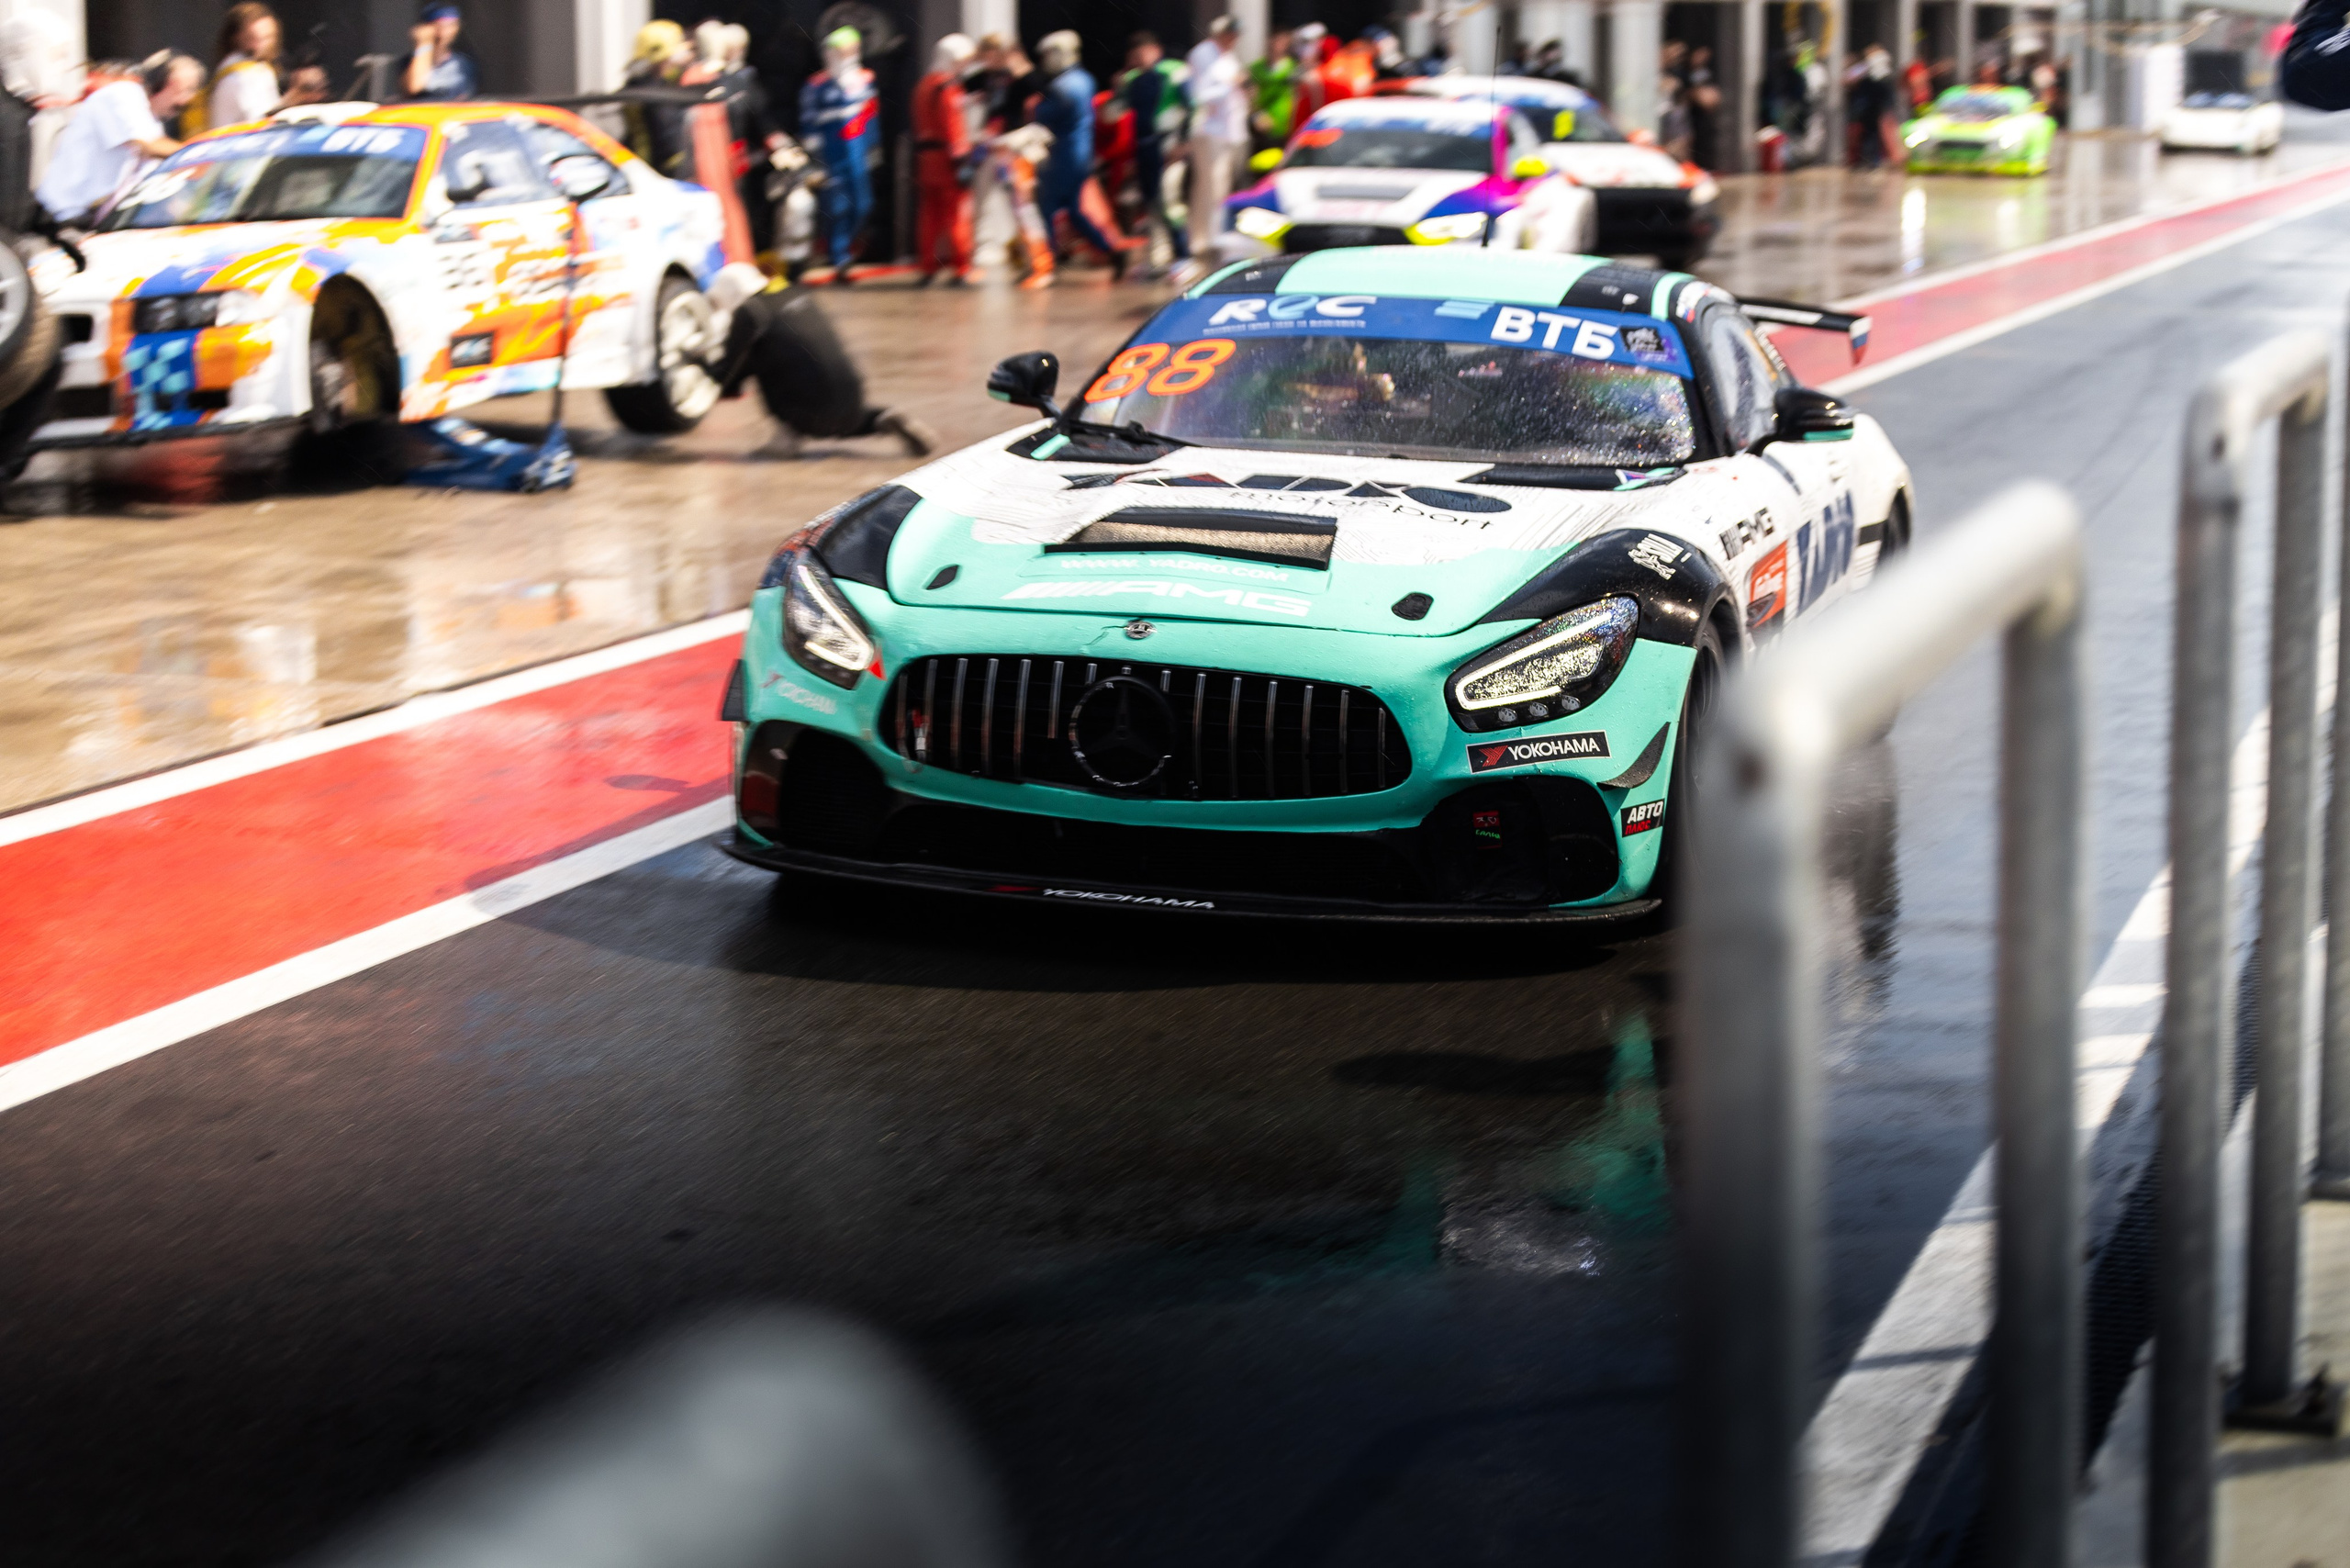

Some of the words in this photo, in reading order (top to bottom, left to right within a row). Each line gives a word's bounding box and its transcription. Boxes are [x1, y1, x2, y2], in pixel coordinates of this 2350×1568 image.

[1490, 306, 1619, 360] ВТБ
[1084, 338, 1237, 404] 88
[1507, 737, 1601, 761] YOKOHAMA
[1627, 801, 1664, 824] АВТО
[1042, 888, 1216, 910] YOKOHAMA
